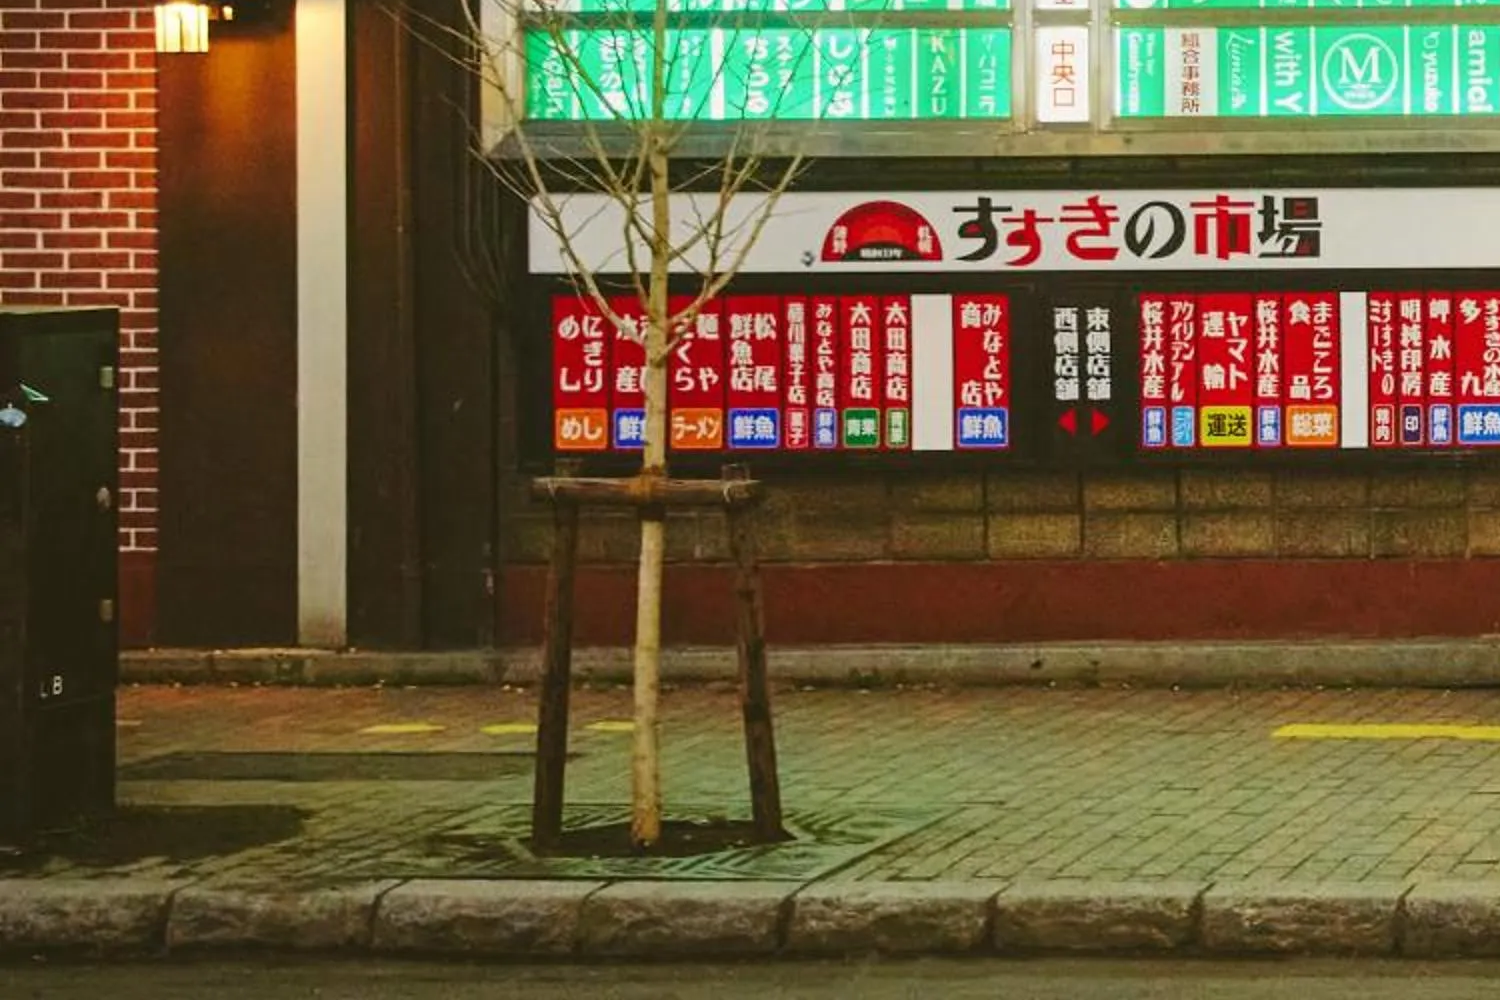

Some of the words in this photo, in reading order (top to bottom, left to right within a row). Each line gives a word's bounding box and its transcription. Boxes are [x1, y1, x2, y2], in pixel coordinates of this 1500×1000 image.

[930, 36, 947, 114] KAZU
[1052, 40, 1075, 106] 中央口
[1273, 31, 1302, 86] with
[1336, 46, 1383, 84] M
[1273, 91, 1304, 113] Y
[952, 195, 1323, 267] すすきの市場
[558, 315, 581, 392] めし
[582, 315, 604, 392] にぎり
[730, 313, 753, 392] 鮮魚店
[755, 313, 777, 392] 松尾
[815, 303, 834, 407] みなとや商店
[850, 302, 872, 400] 太田商店
[885, 302, 907, 401] 太田商店
[982, 303, 1003, 407] みなとや
[1054, 307, 1079, 400] 西側店舗
[1086, 307, 1111, 400] 東側店舗
[1142, 301, 1164, 399] 桜井水産
[1203, 311, 1225, 390] 運輸
[1227, 312, 1248, 390] ヤマト
[1256, 301, 1280, 399] 桜井水産
[1289, 300, 1311, 400] 食品
[1313, 301, 1333, 399] まごころ
[1370, 299, 1382, 373] ミート
[1381, 299, 1394, 395] すすきの
[561, 416, 603, 440] めし
[672, 417, 721, 440] ラーメン
[733, 415, 775, 440] 鮮魚
[962, 414, 1003, 439] 鮮魚
[1207, 413, 1247, 437] 運送
[1405, 415, 1419, 431] 印
